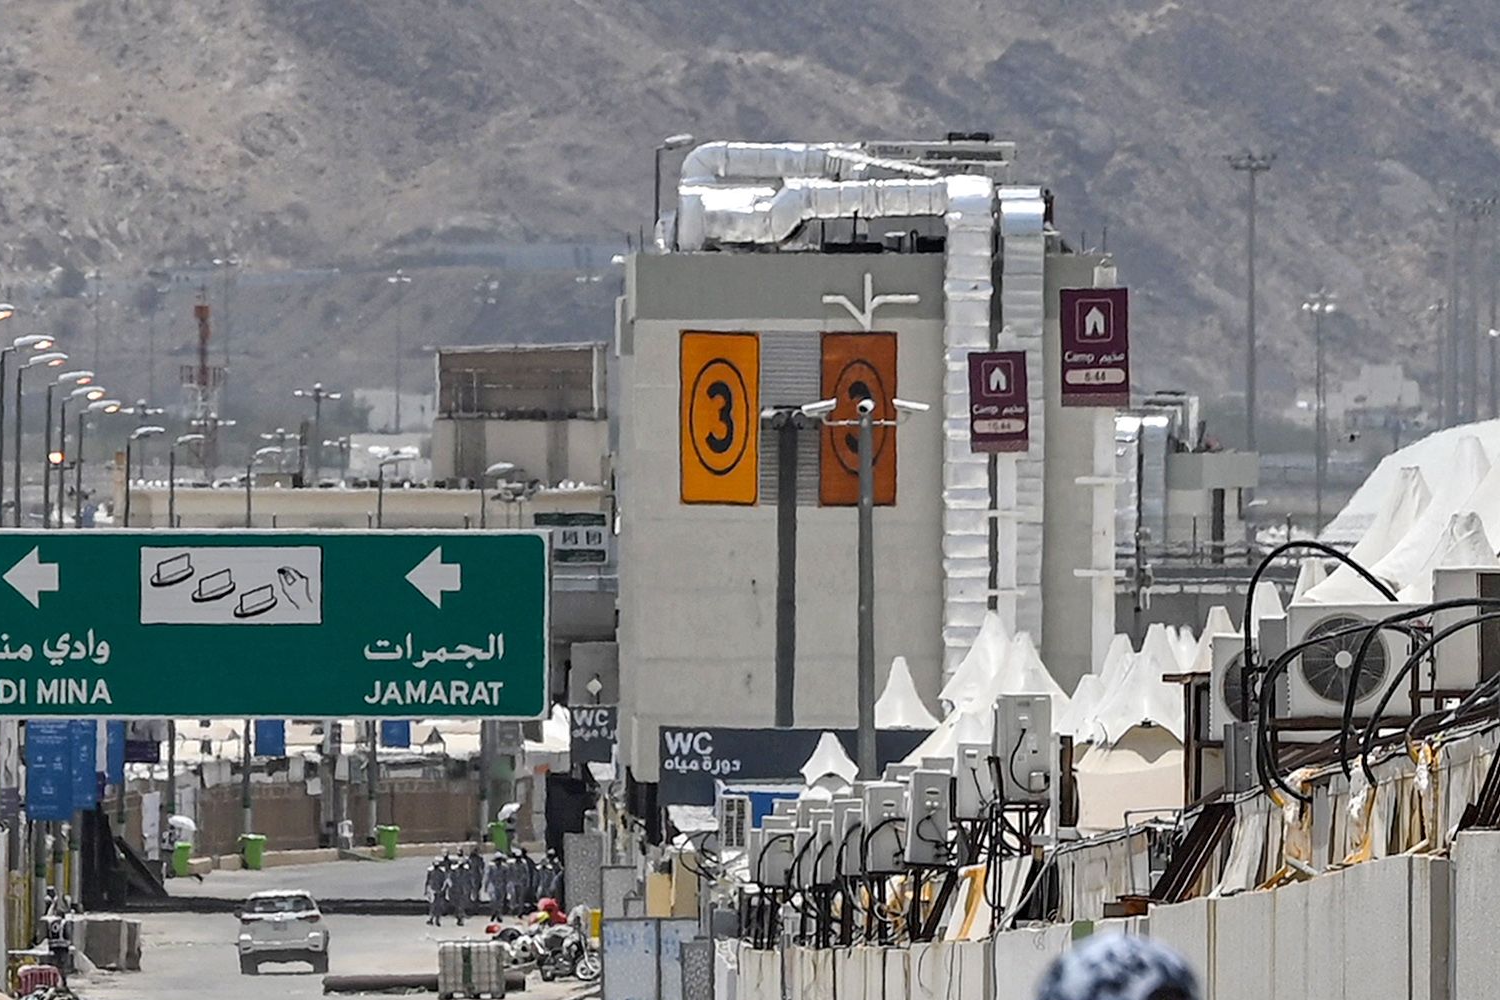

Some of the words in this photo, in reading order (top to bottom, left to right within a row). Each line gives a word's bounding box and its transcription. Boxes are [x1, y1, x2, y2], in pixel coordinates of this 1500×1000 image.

[1064, 351, 1095, 365] Camp
[705, 383, 735, 454] 3
[972, 403, 999, 416] Camp
[43, 628, 112, 667] وادي
[364, 632, 506, 670] الجمرات
[37, 679, 112, 705] MINA
[364, 681, 504, 705] JAMARAT
[573, 709, 609, 727] WC
[572, 728, 599, 741] مياه
[600, 726, 614, 740] رة
[664, 731, 713, 755] WC
[664, 757, 700, 774] مياه
[703, 756, 741, 775] دورة
